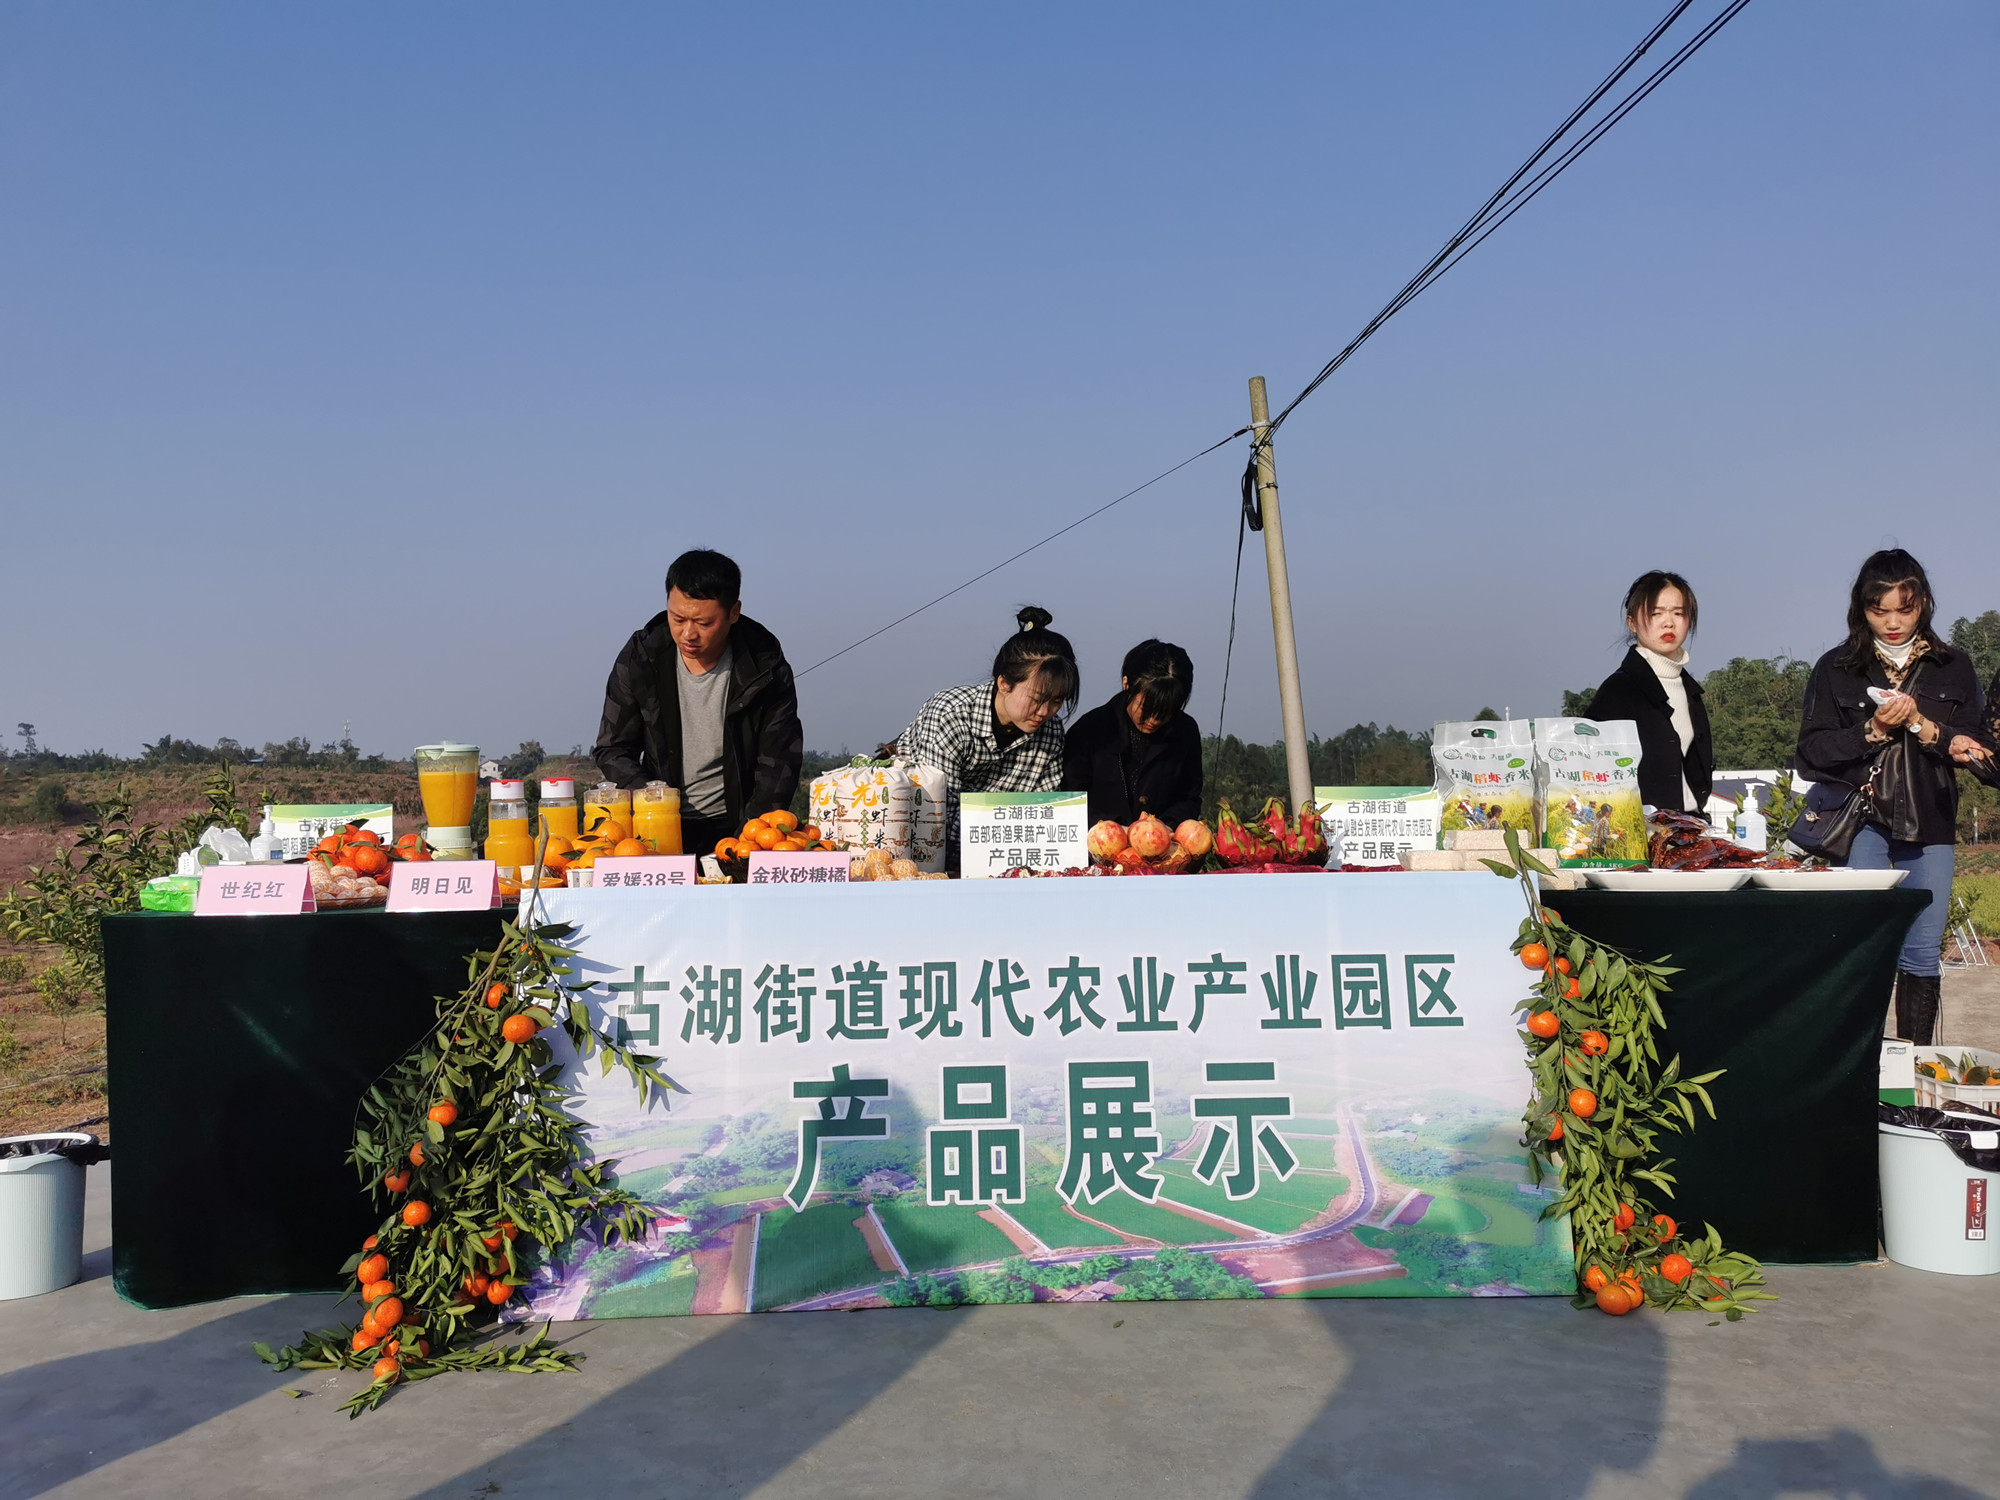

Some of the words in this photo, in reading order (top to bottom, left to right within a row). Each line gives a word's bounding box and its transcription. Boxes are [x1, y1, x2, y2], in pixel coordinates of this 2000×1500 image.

[992, 805, 1055, 821] 古湖街道
[1347, 800, 1408, 815] 古湖街道
[298, 817, 359, 833] 古湖街
[969, 824, 1079, 844] 西部稻渔果蔬产业园区
[281, 836, 323, 855] 部稻渔果
[988, 847, 1061, 867] 产品展示
[602, 871, 687, 887] 爱媛38号
[752, 866, 848, 884] 金秋砂糖橘
[220, 881, 286, 899] 世纪红
[410, 876, 473, 895] 明日见
[607, 952, 1465, 1047] 古湖街道现代农业产业园区
[785, 1060, 1297, 1211] 产品展示
